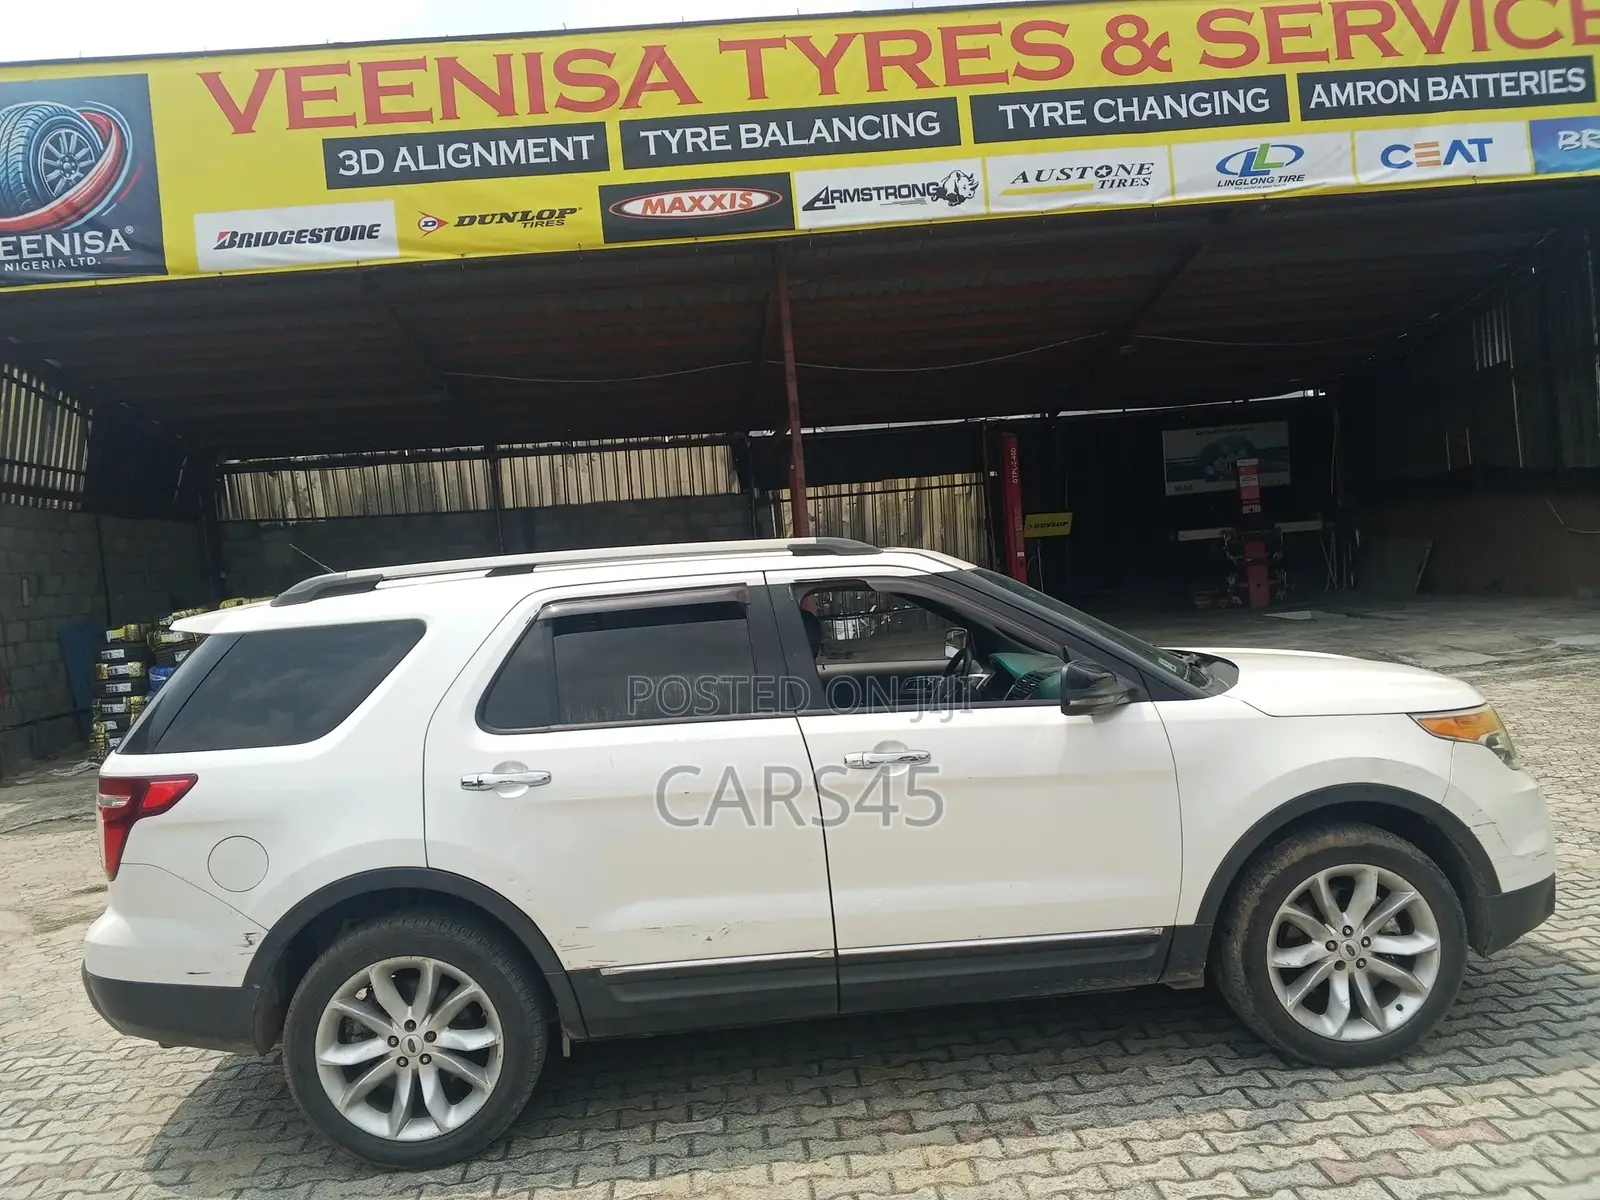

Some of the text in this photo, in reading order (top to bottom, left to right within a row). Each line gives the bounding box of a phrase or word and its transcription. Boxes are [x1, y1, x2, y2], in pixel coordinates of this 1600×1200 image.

[197, 45, 703, 135] VEENISA
[718, 20, 1075, 99] TYRES
[1101, 14, 1173, 76] &
[1309, 67, 1587, 109] AMRON BATTERIES
[998, 88, 1271, 130] TYRE CHANGING
[640, 110, 941, 156] TYRE BALANCING
[338, 135, 595, 177] 3D ALIGNMENT
[1380, 137, 1493, 170] CEAT
[1011, 162, 1155, 185] AUSTONE
[1098, 177, 1151, 190] TIRES
[1217, 176, 1275, 187] LINGLONG
[1277, 174, 1306, 183] TIRE
[641, 191, 753, 216] MAXXIS
[802, 182, 940, 212] ARMSTRONG
[454, 207, 578, 228] DUNLOP
[522, 219, 565, 229] TIRES
[213, 223, 381, 251] BRIDGESTONE
[4, 256, 101, 272] NIGERIA LTD.
[1033, 521, 1069, 529] DUNLOP
